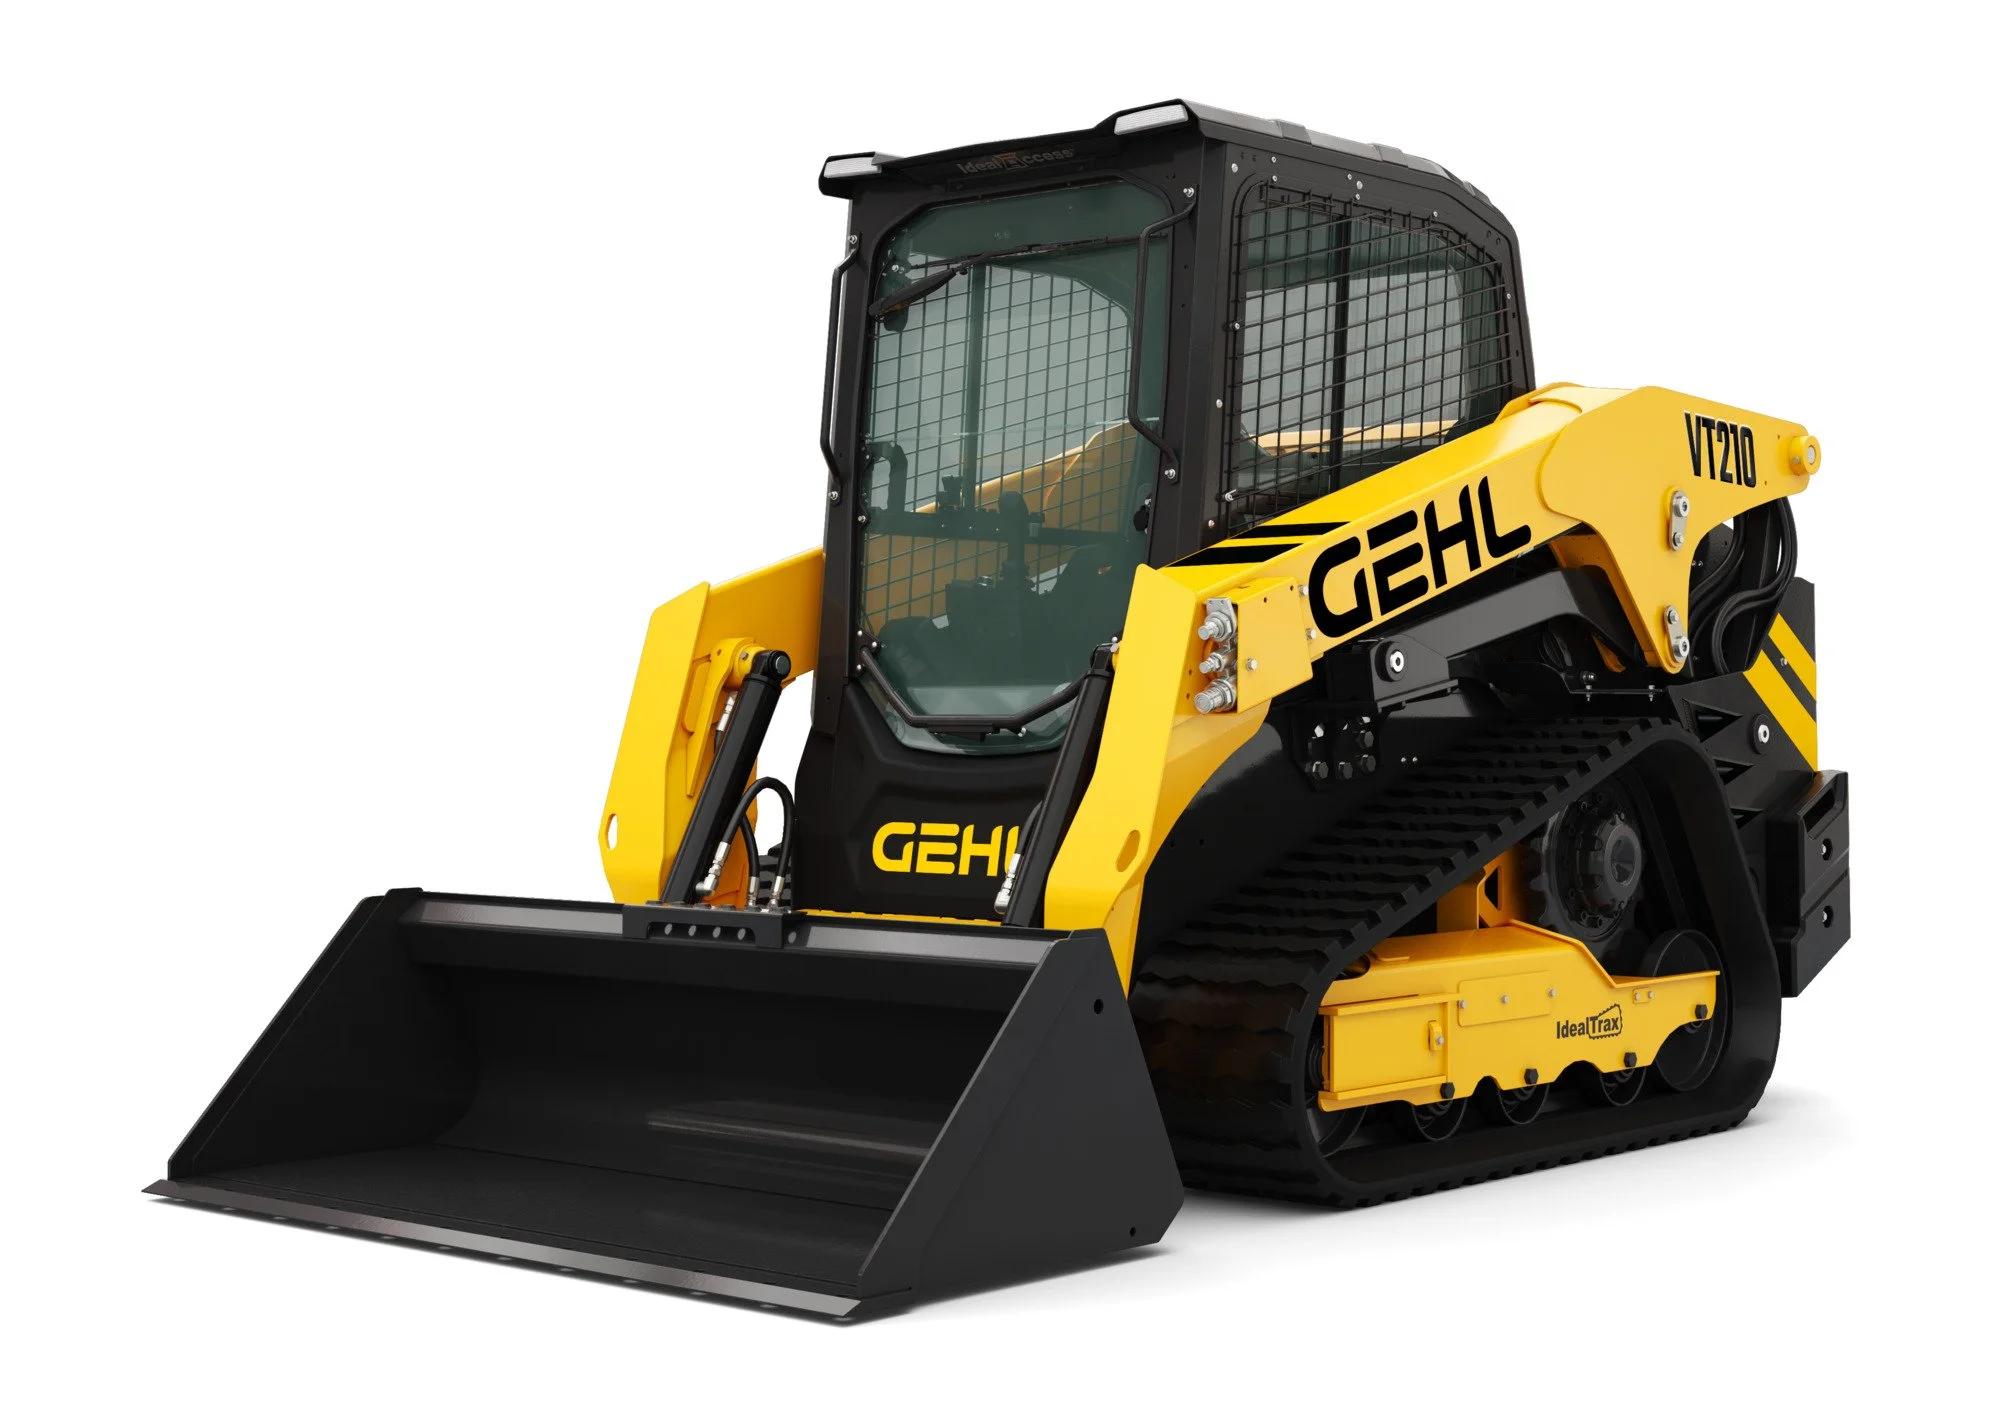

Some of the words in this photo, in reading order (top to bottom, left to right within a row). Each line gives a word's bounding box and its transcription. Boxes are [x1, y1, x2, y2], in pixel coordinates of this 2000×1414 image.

[1684, 411, 1757, 488] VT210
[1309, 475, 1532, 638] GEHL
[1556, 1014, 1620, 1039] IdealTrax
